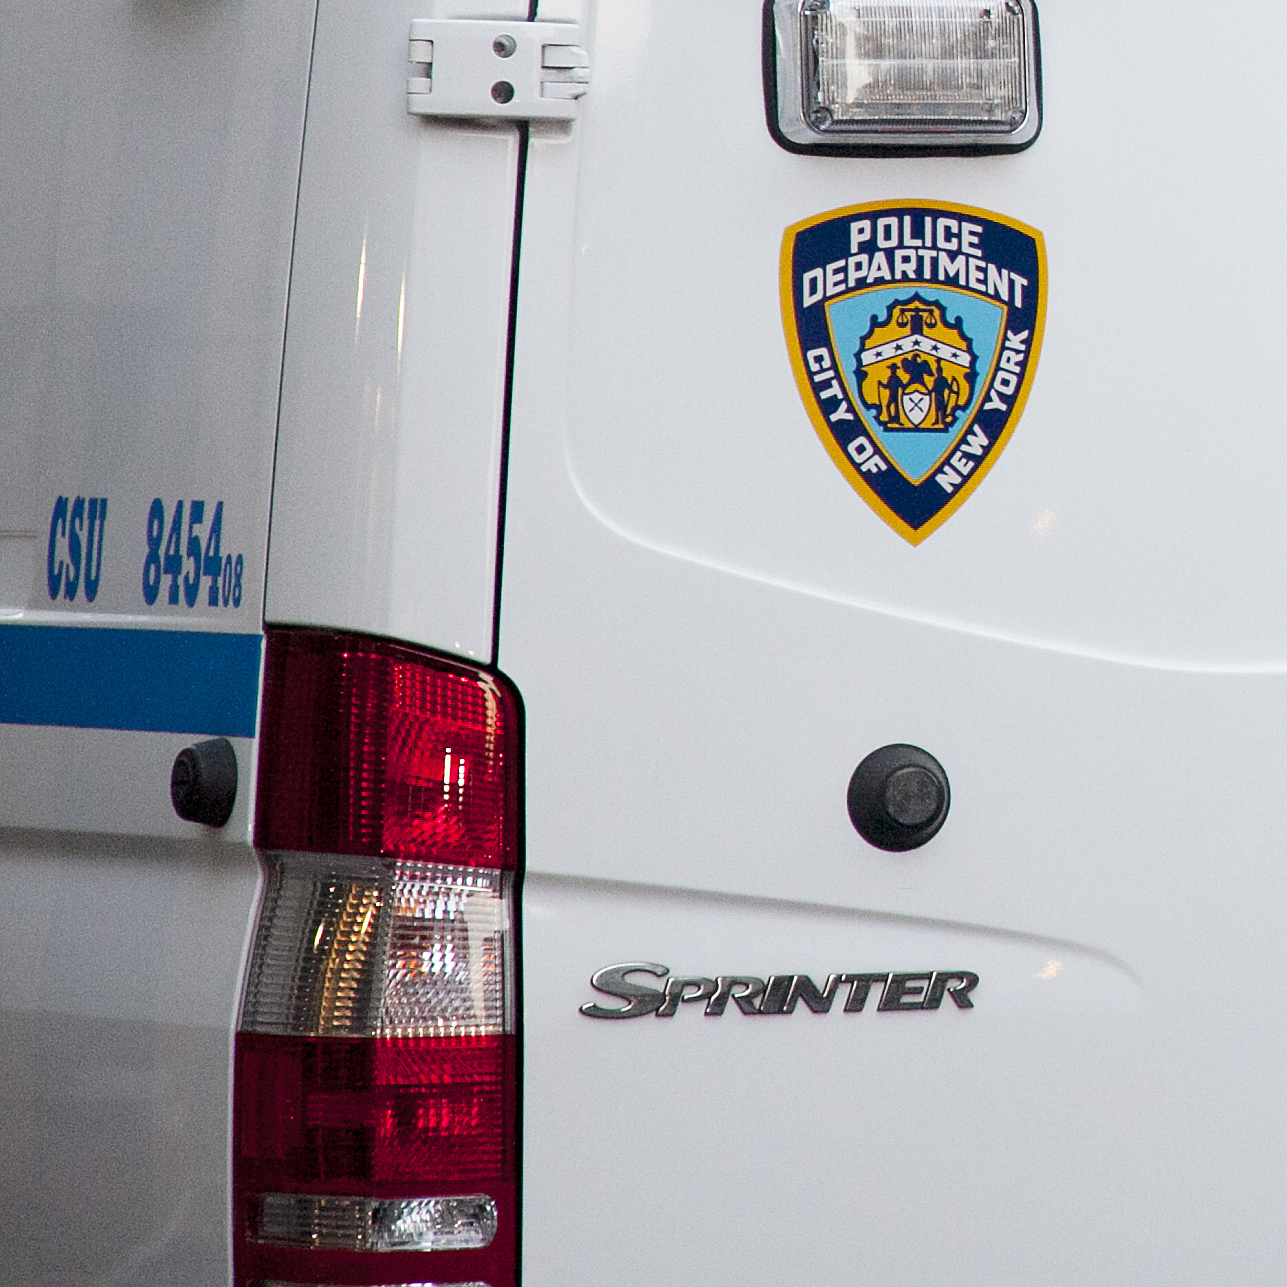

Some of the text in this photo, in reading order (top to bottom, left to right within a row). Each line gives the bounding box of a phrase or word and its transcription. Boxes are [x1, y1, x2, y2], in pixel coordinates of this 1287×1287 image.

[850, 215, 983, 257] POLICE
[802, 248, 1029, 308] DEPARTMENT
[806, 329, 1030, 494] CITY OF NEW YORK
[47, 495, 108, 602] CSU
[579, 961, 980, 1020] SPRINTER
